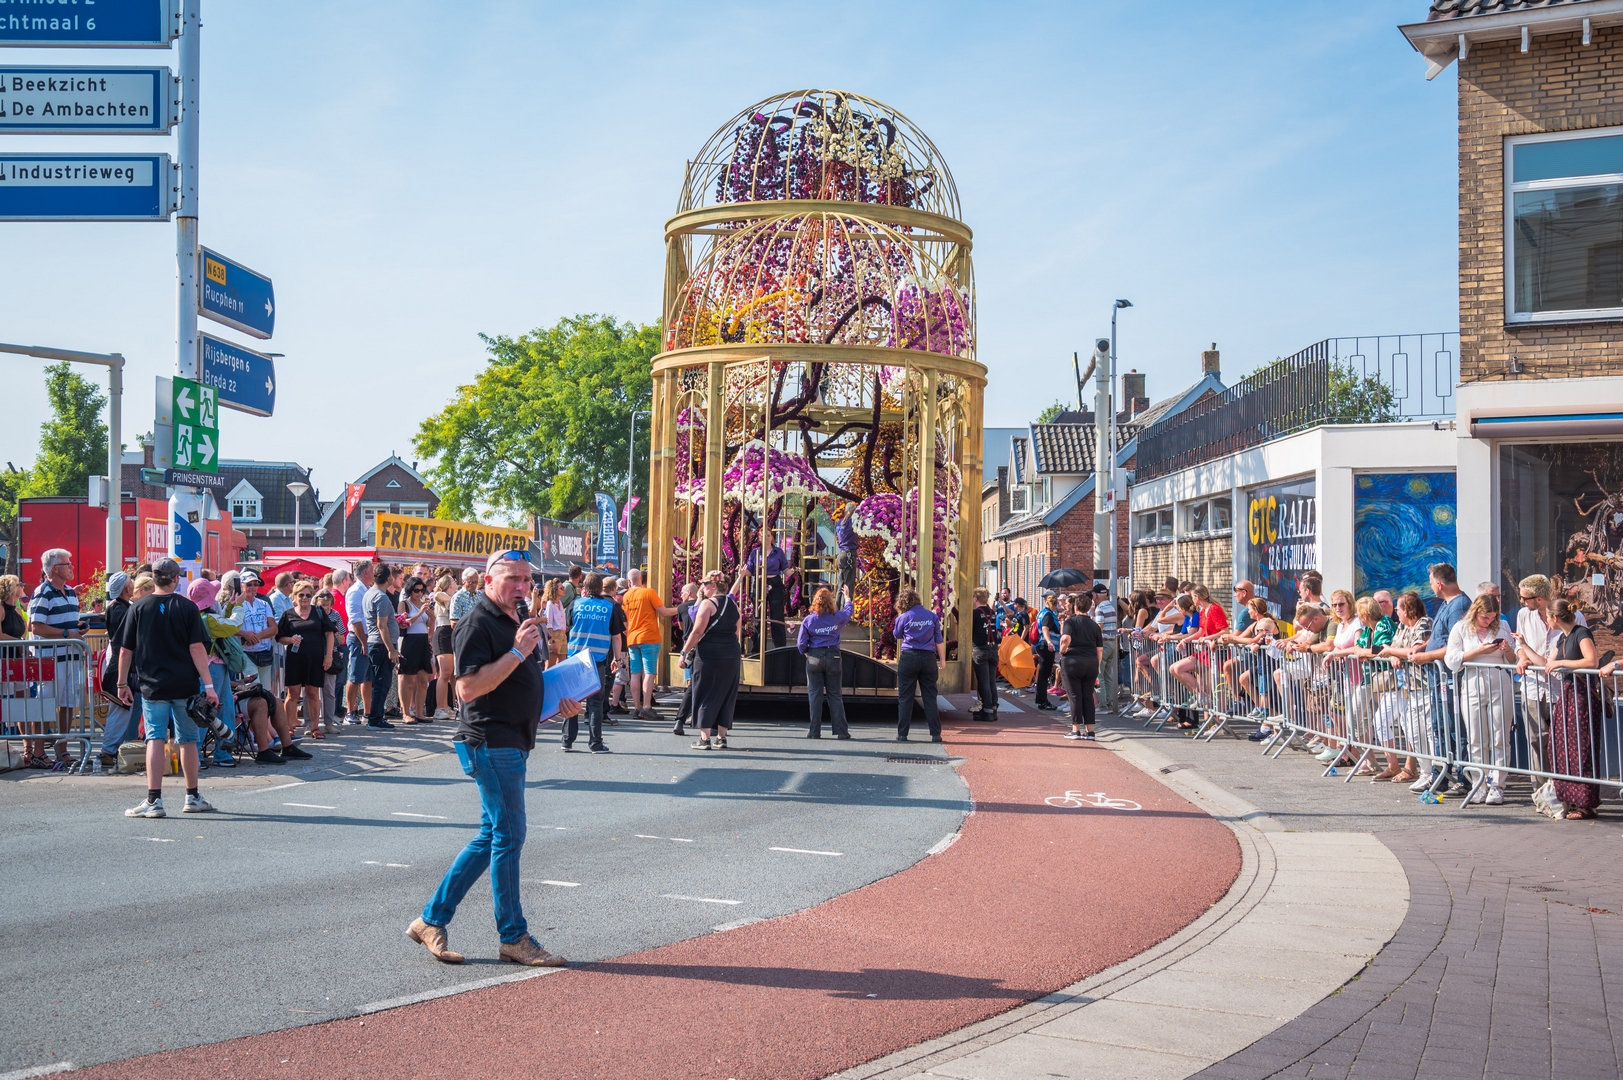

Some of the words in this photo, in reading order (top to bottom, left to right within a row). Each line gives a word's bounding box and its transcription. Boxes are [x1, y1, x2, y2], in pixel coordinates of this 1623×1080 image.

[86, 18, 96, 31] 6
[12, 77, 107, 92] Beekzicht
[12, 102, 35, 117] De
[42, 101, 149, 117] Ambachten
[11, 164, 134, 184] Industrieweg
[205, 284, 237, 311] Rucphen
[238, 301, 244, 314] 11
[205, 344, 245, 372] Rijsbergen
[245, 360, 250, 373] 6
[205, 369, 227, 390] Breda
[228, 379, 237, 393] 22
[172, 472, 225, 486] PRINSENSTRAAT
[1249, 495, 1277, 546] GTC
[1278, 498, 1316, 539] RALL
[1289, 544, 1303, 570] JULI
[578, 604, 608, 614] corso
